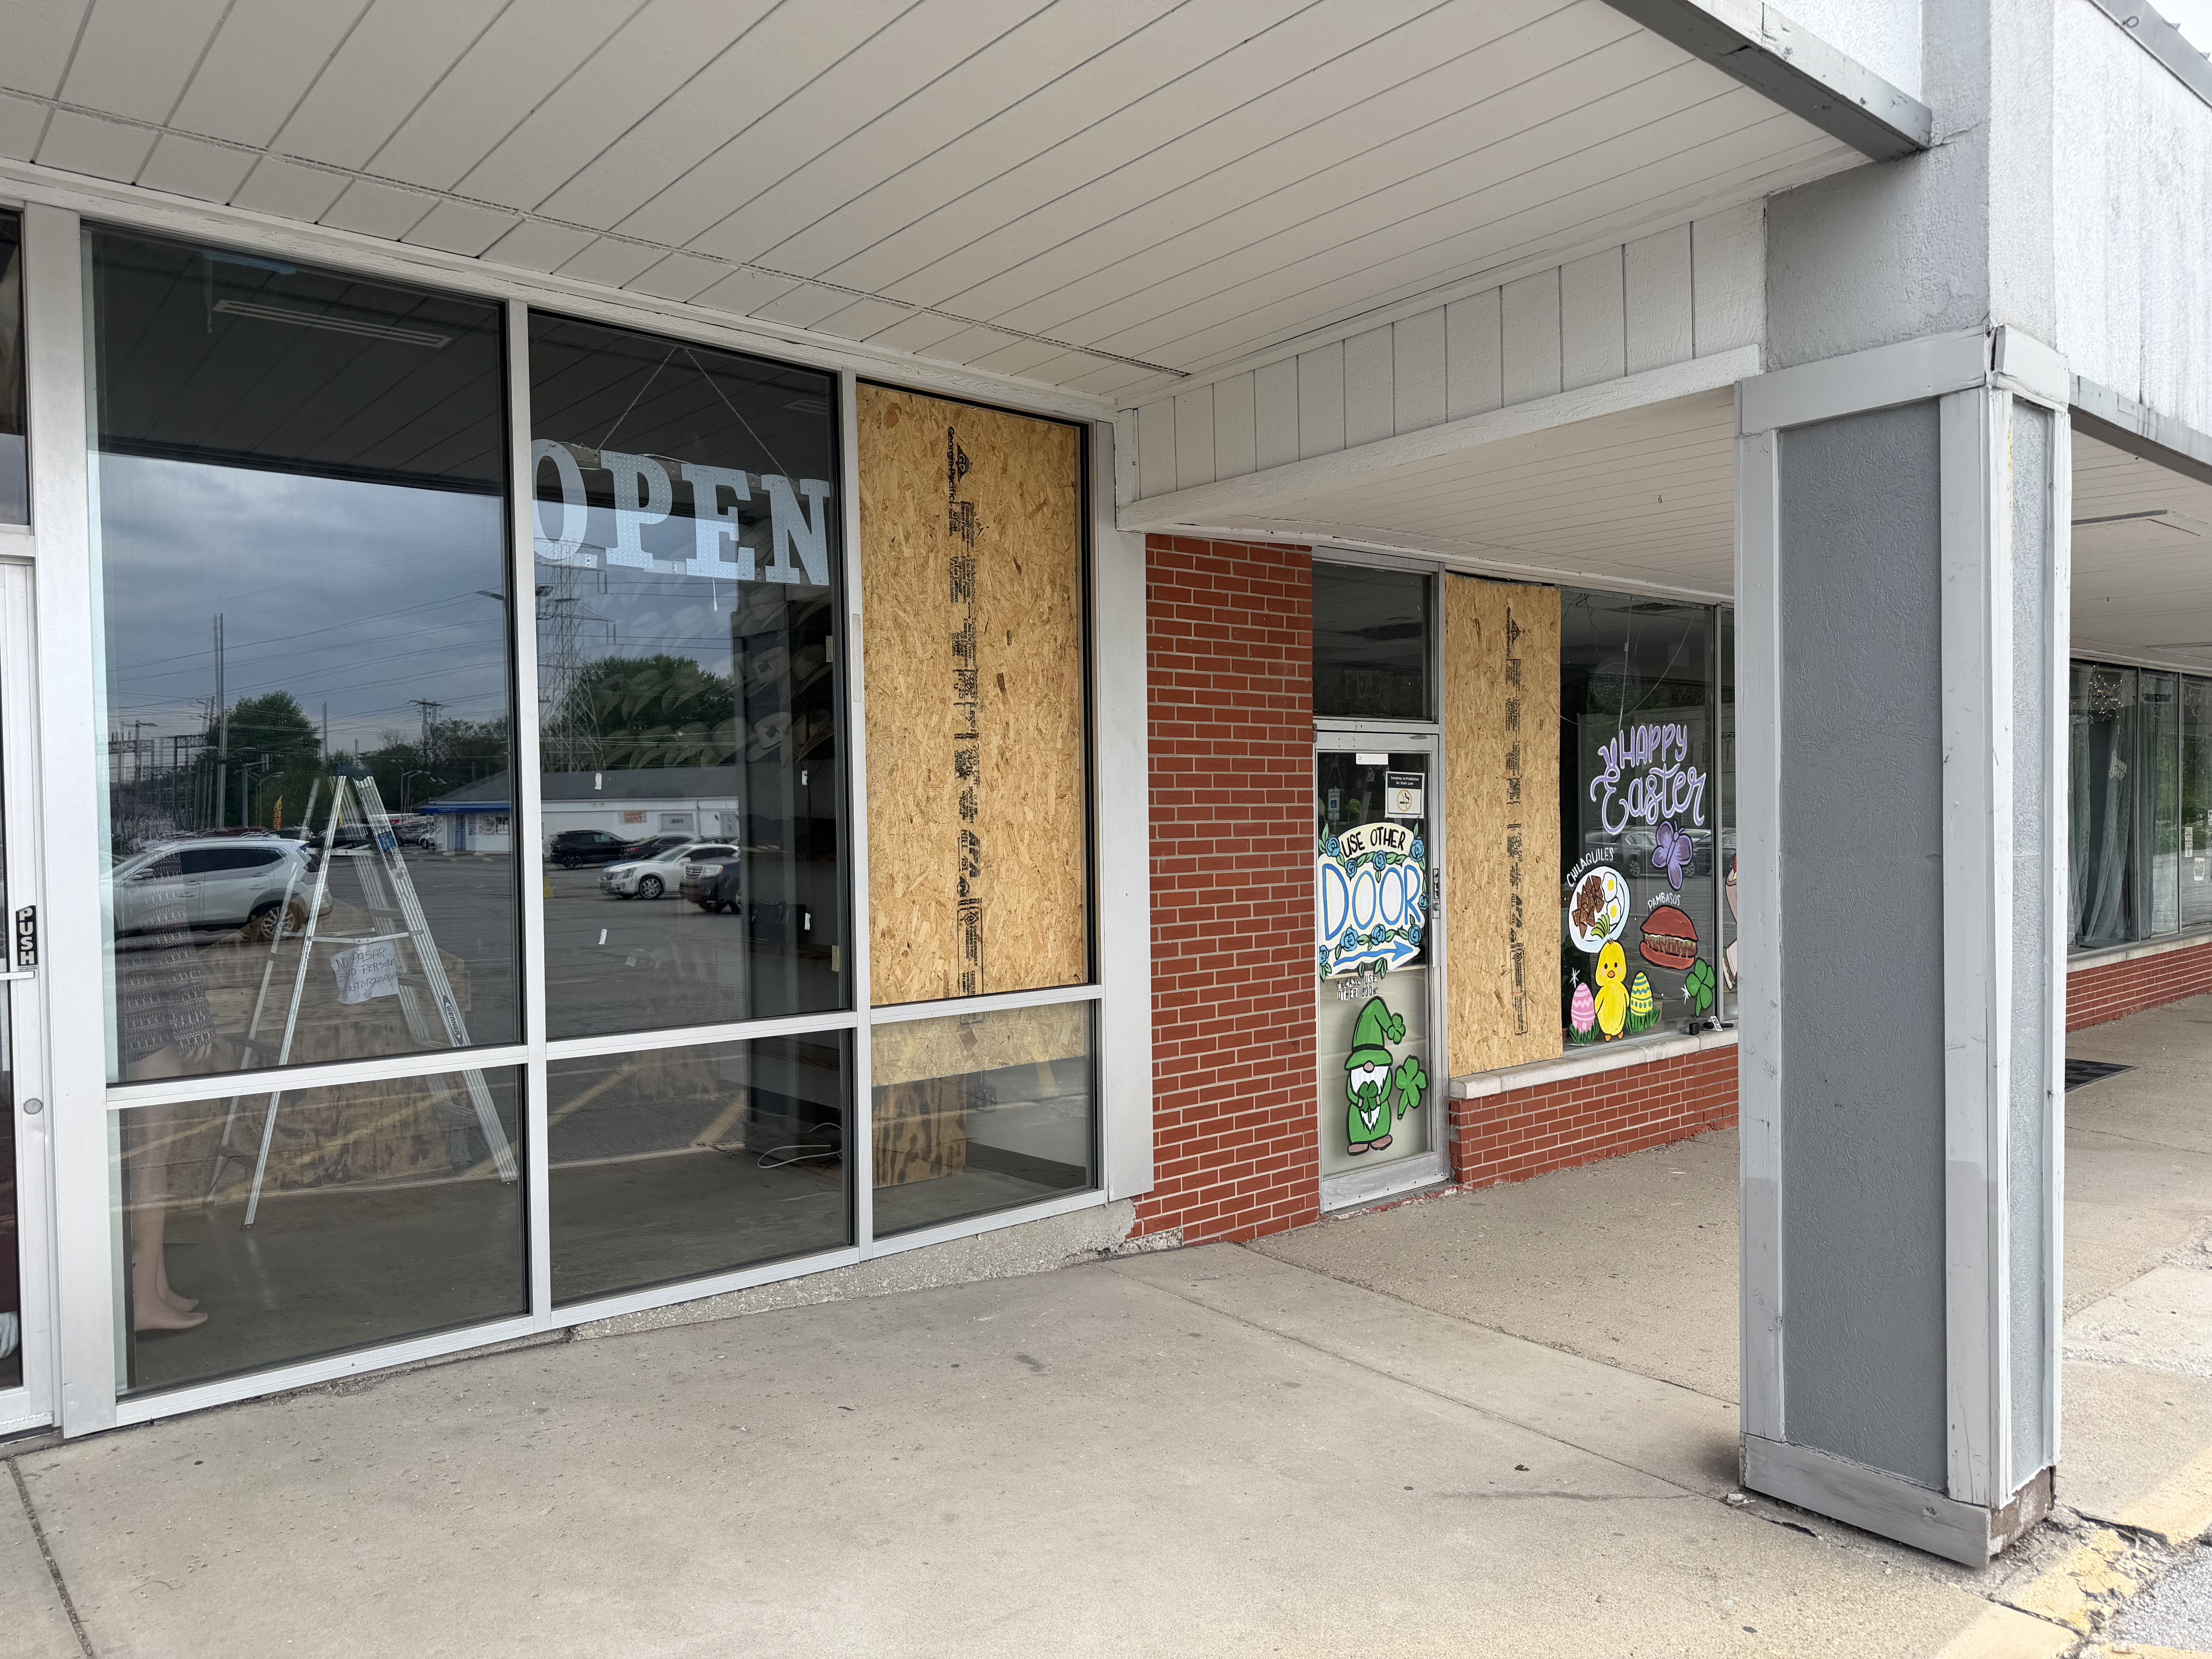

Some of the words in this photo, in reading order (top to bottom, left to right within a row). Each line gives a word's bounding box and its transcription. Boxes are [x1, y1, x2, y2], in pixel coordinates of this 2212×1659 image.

[947, 426, 955, 503] Georgia-Pacific
[959, 453, 965, 472] GP
[531, 439, 831, 586] OPEN
[1619, 723, 1688, 769] HAPPY
[1590, 763, 1707, 836] Easter
[1341, 831, 1365, 858] USE
[1370, 826, 1406, 851] OTHER
[1566, 847, 1614, 888] CHILAQUILES
[1322, 863, 1421, 941] DOOR
[1647, 892, 1681, 912] PAMBASOS
[19, 907, 35, 965] PUSH
[336, 957, 348, 970] NO
[352, 947, 385, 964] PASAR
[361, 958, 395, 974] PERSONA
[345, 972, 397, 995] AUTORIZADA
[446, 1005, 460, 1037] WERNER
